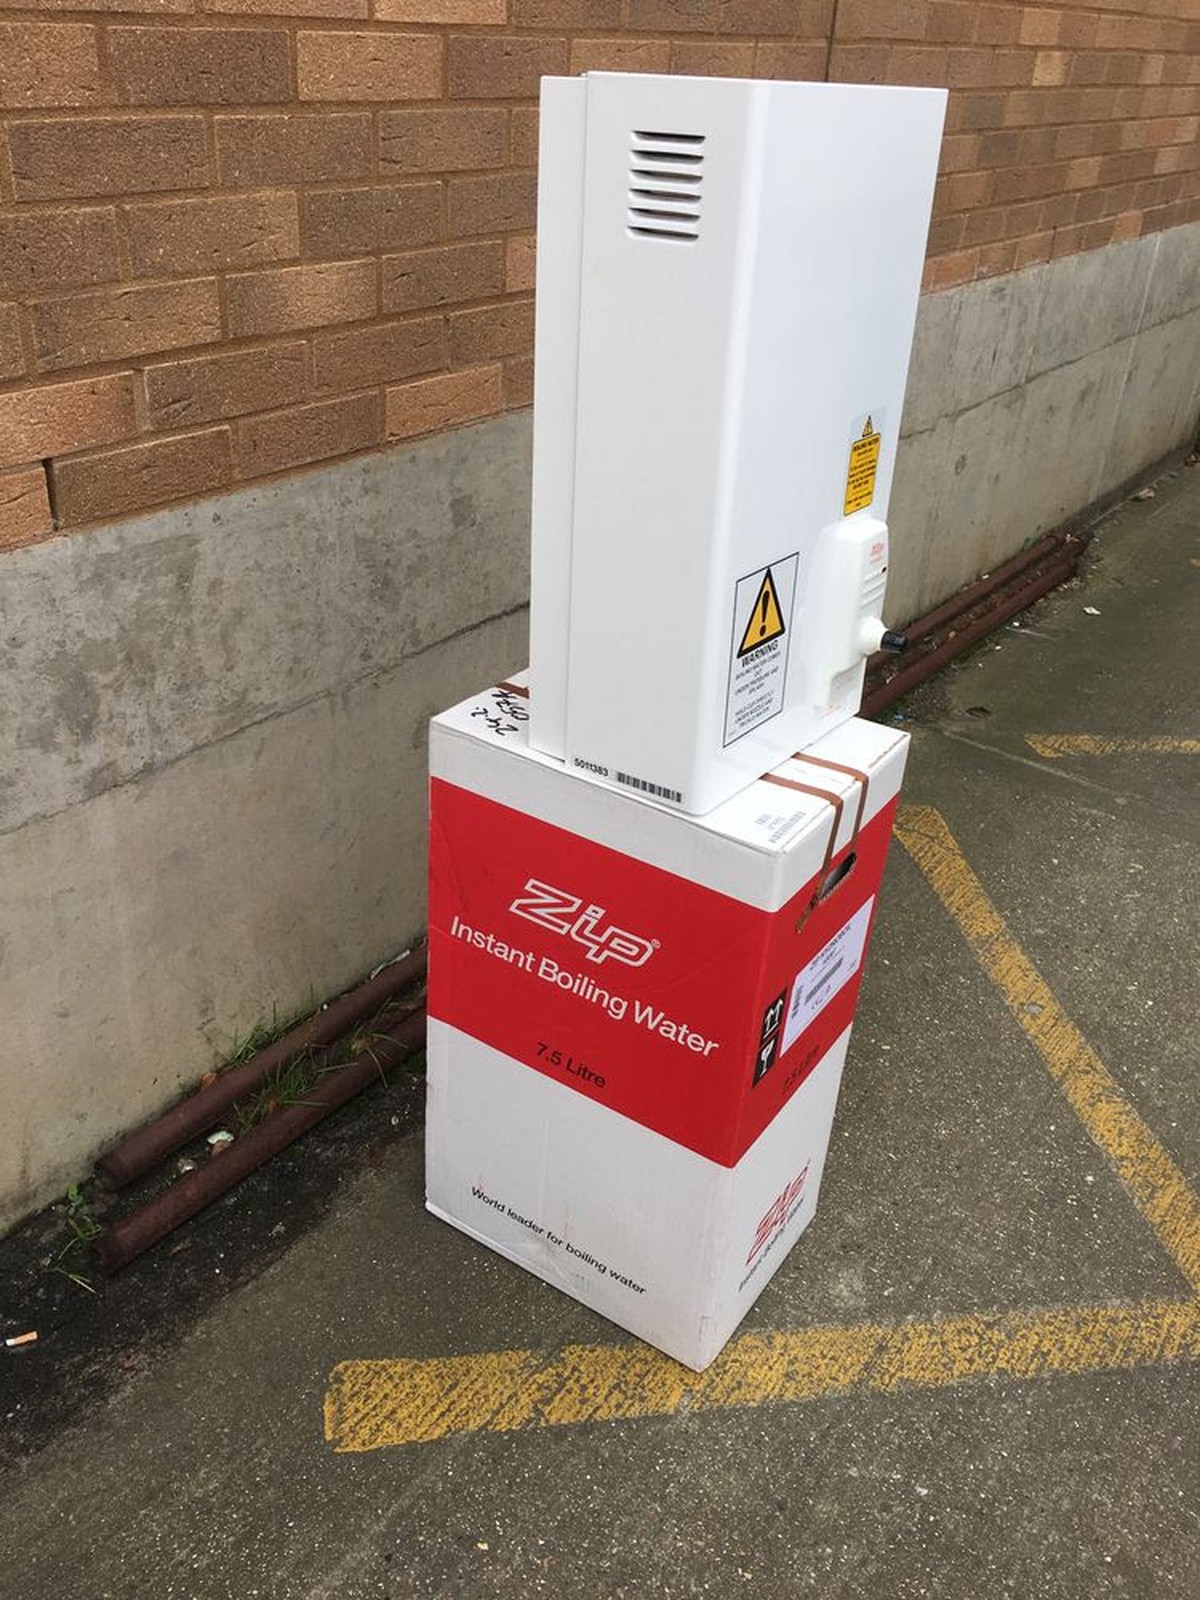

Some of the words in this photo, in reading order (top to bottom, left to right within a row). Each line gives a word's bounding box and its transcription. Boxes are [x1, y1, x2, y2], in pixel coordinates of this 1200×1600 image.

[741, 639, 779, 668] WARNING
[574, 758, 609, 776] 5011383
[450, 916, 535, 973] Instant
[537, 957, 628, 1020] Boiling
[633, 1000, 720, 1057] Water
[536, 1042, 562, 1066] 7.5
[565, 1058, 606, 1089] Litre
[471, 1186, 506, 1212] World
[506, 1208, 544, 1235] leader
[546, 1231, 564, 1247] for
[565, 1243, 608, 1275] boiling
[609, 1269, 647, 1295] water
